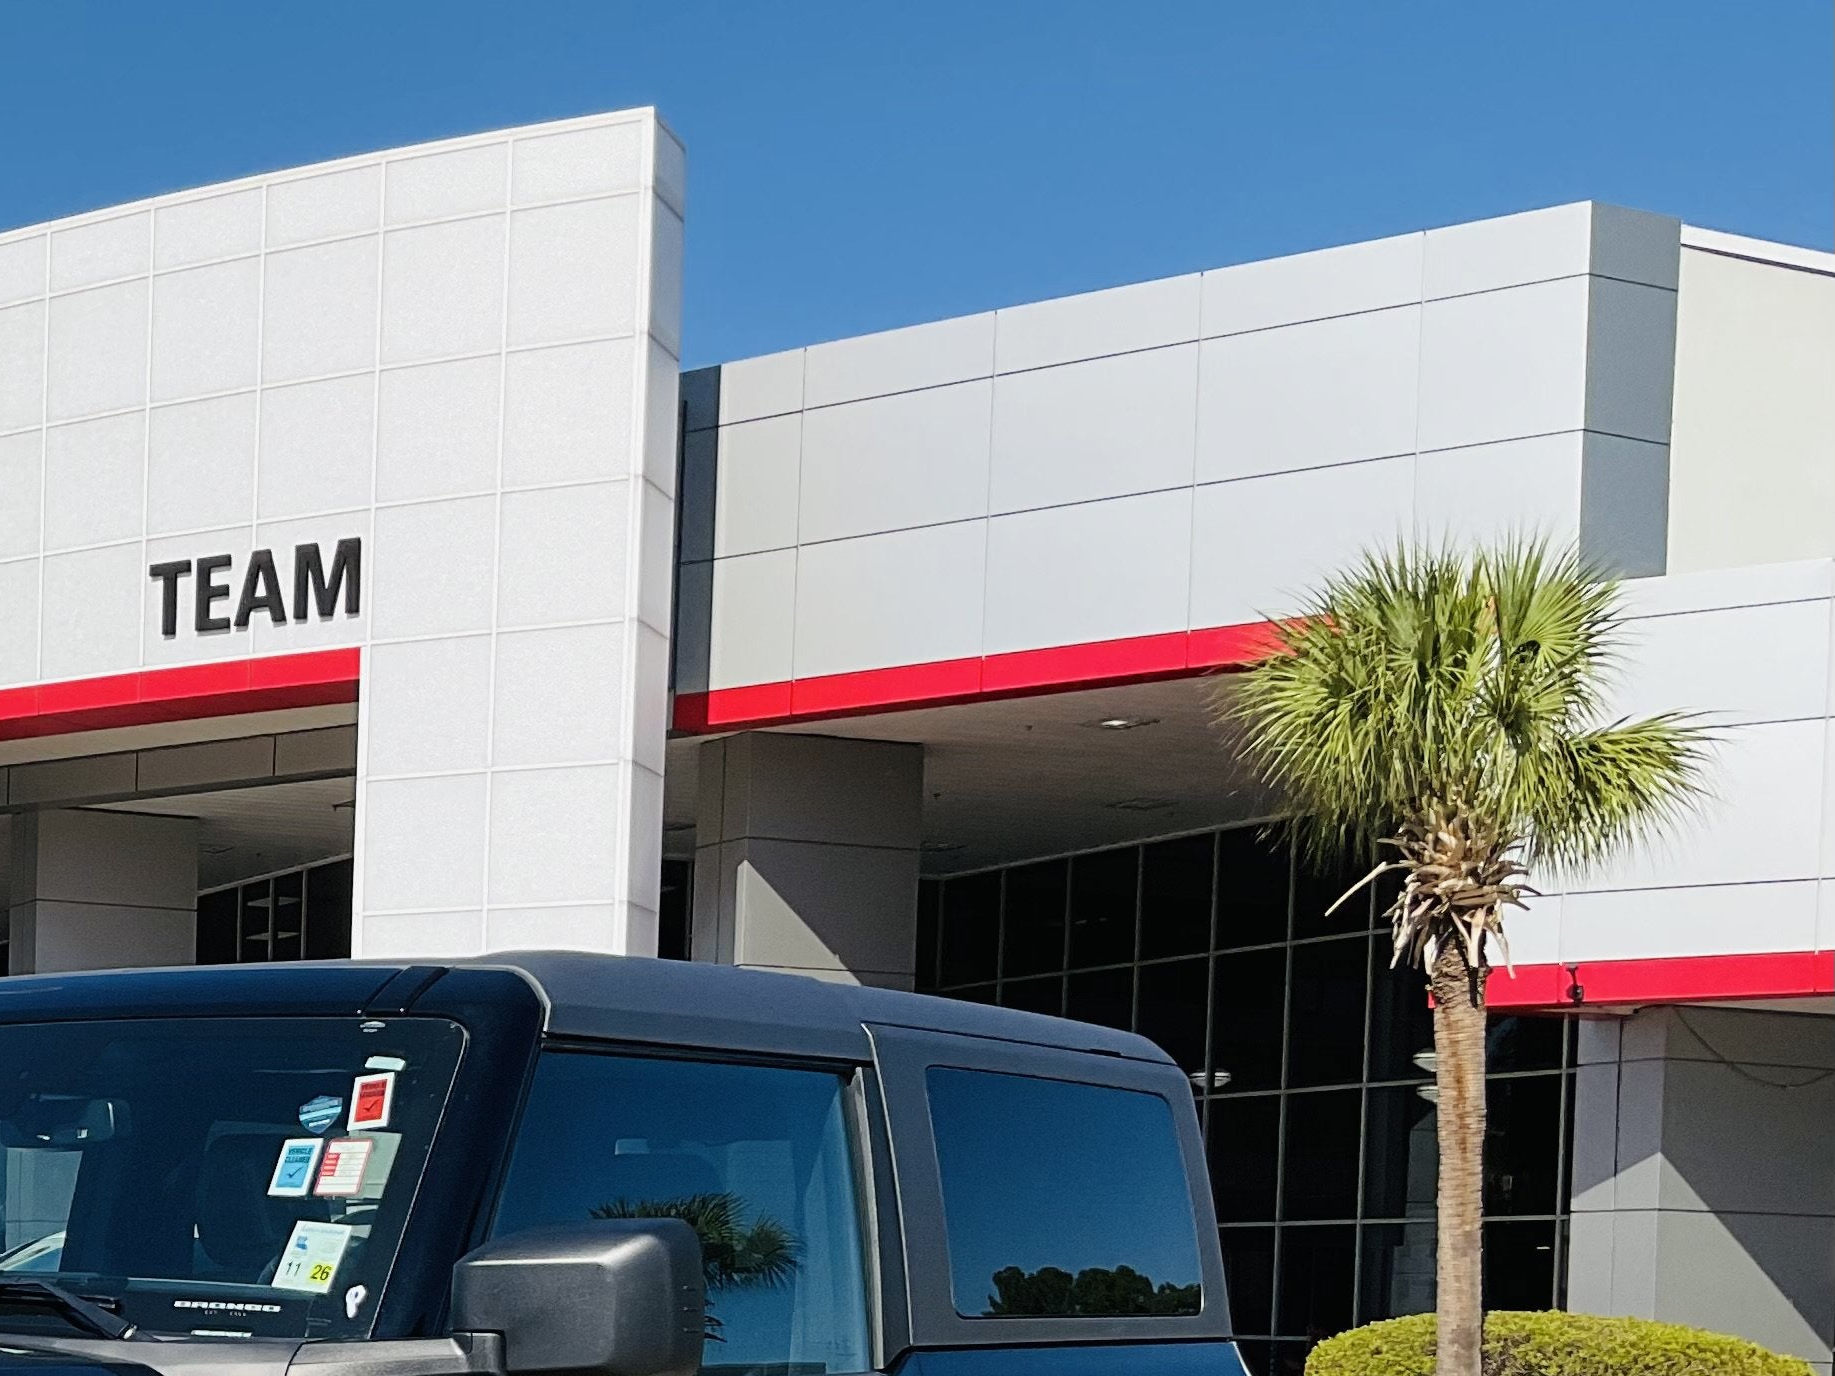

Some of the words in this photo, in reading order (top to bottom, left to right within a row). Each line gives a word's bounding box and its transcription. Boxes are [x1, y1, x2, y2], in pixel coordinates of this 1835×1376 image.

[149, 536, 362, 637] TEAM
[286, 1260, 301, 1277] 11
[310, 1264, 333, 1281] 26
[174, 1300, 281, 1313] BRONCO
